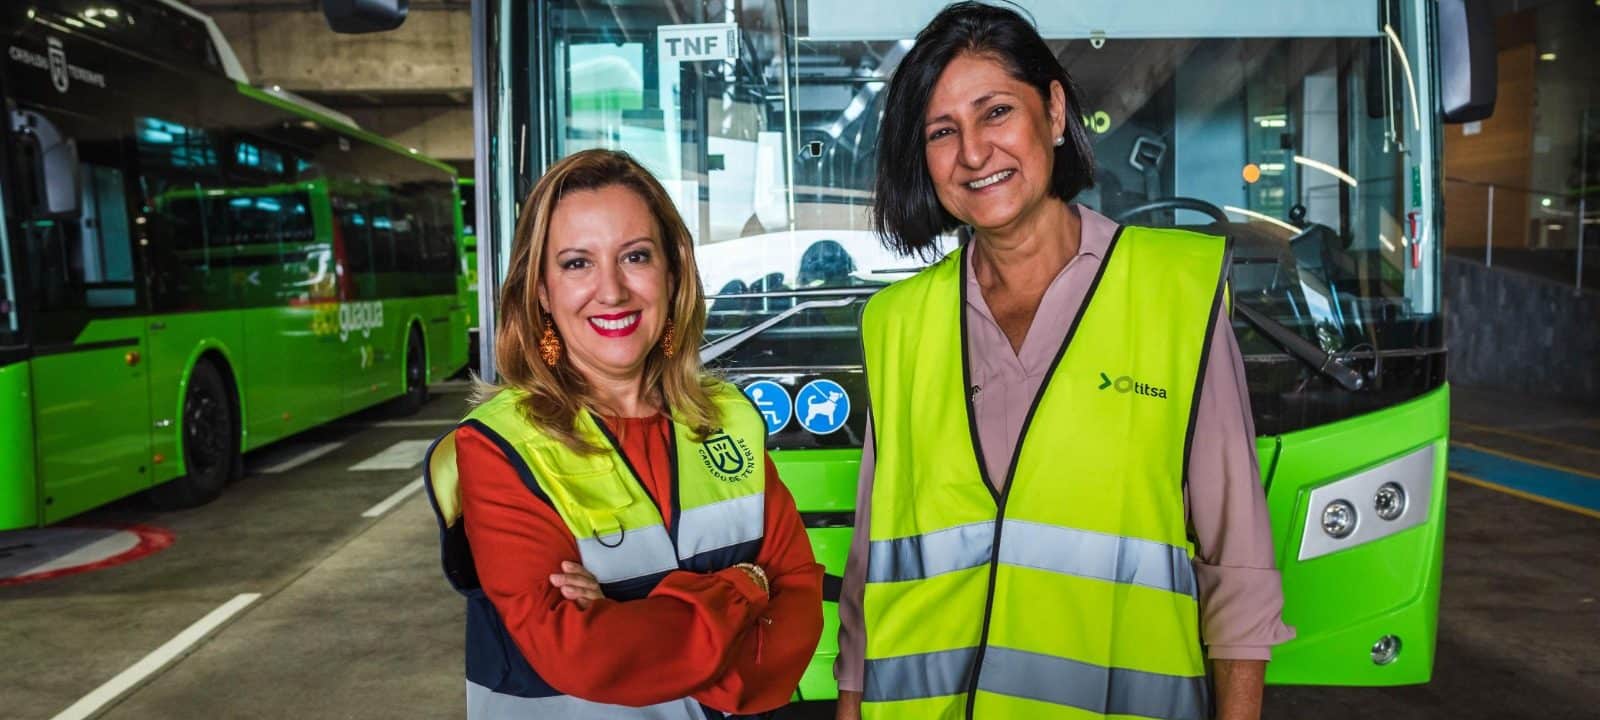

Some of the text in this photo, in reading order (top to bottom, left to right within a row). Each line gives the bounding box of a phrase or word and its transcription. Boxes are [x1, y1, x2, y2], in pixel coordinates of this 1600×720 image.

[664, 36, 718, 57] TNF
[1134, 381, 1167, 400] titsa
[698, 437, 755, 483] CABILDO DE TENERIFE
